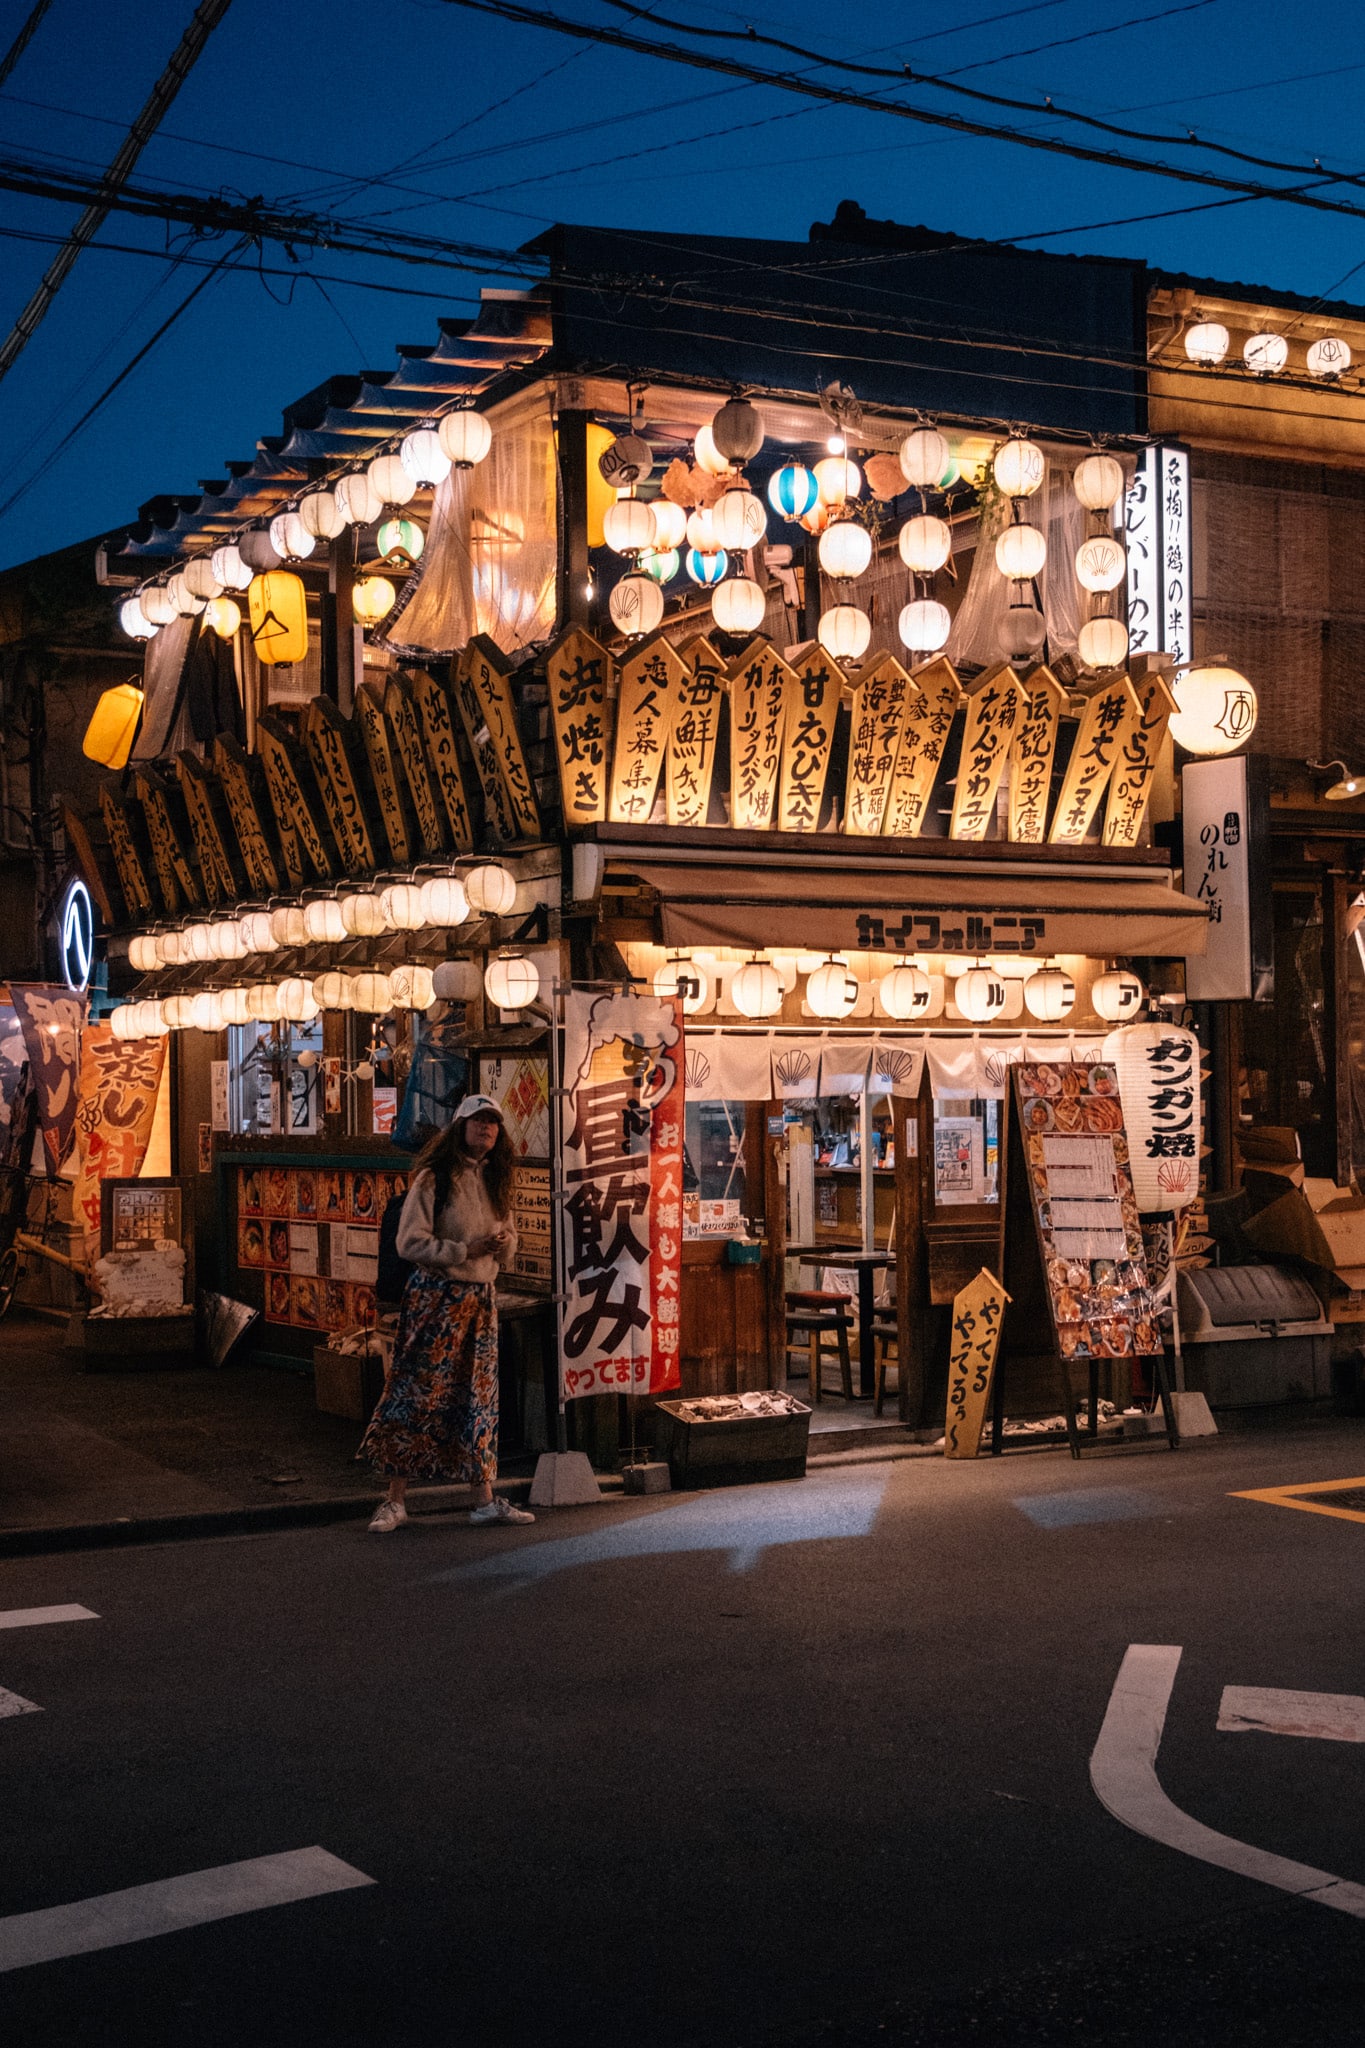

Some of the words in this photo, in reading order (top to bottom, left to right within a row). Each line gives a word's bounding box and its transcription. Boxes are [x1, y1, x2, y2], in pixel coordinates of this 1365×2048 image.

[1165, 457, 1184, 685] 名物!!鶏の半身
[557, 656, 604, 812] 浜焼き
[619, 655, 669, 814] 恋人募集中
[763, 663, 785, 783] ホタルイカの
[787, 666, 830, 832] 甘えびキムチ
[919, 687, 955, 763] お客様
[996, 687, 1018, 729] 名物
[856, 914, 1045, 950] カイフォルニア
[1198, 823, 1229, 923] のれん街
[1146, 1038, 1196, 1158] ガンガン焼
[563, 1079, 652, 1359] 昼飲み
[655, 1120, 680, 1381] お一人様も大歓迎!
[565, 1353, 650, 1395] やってます
[972, 1296, 1000, 1394] やってる
